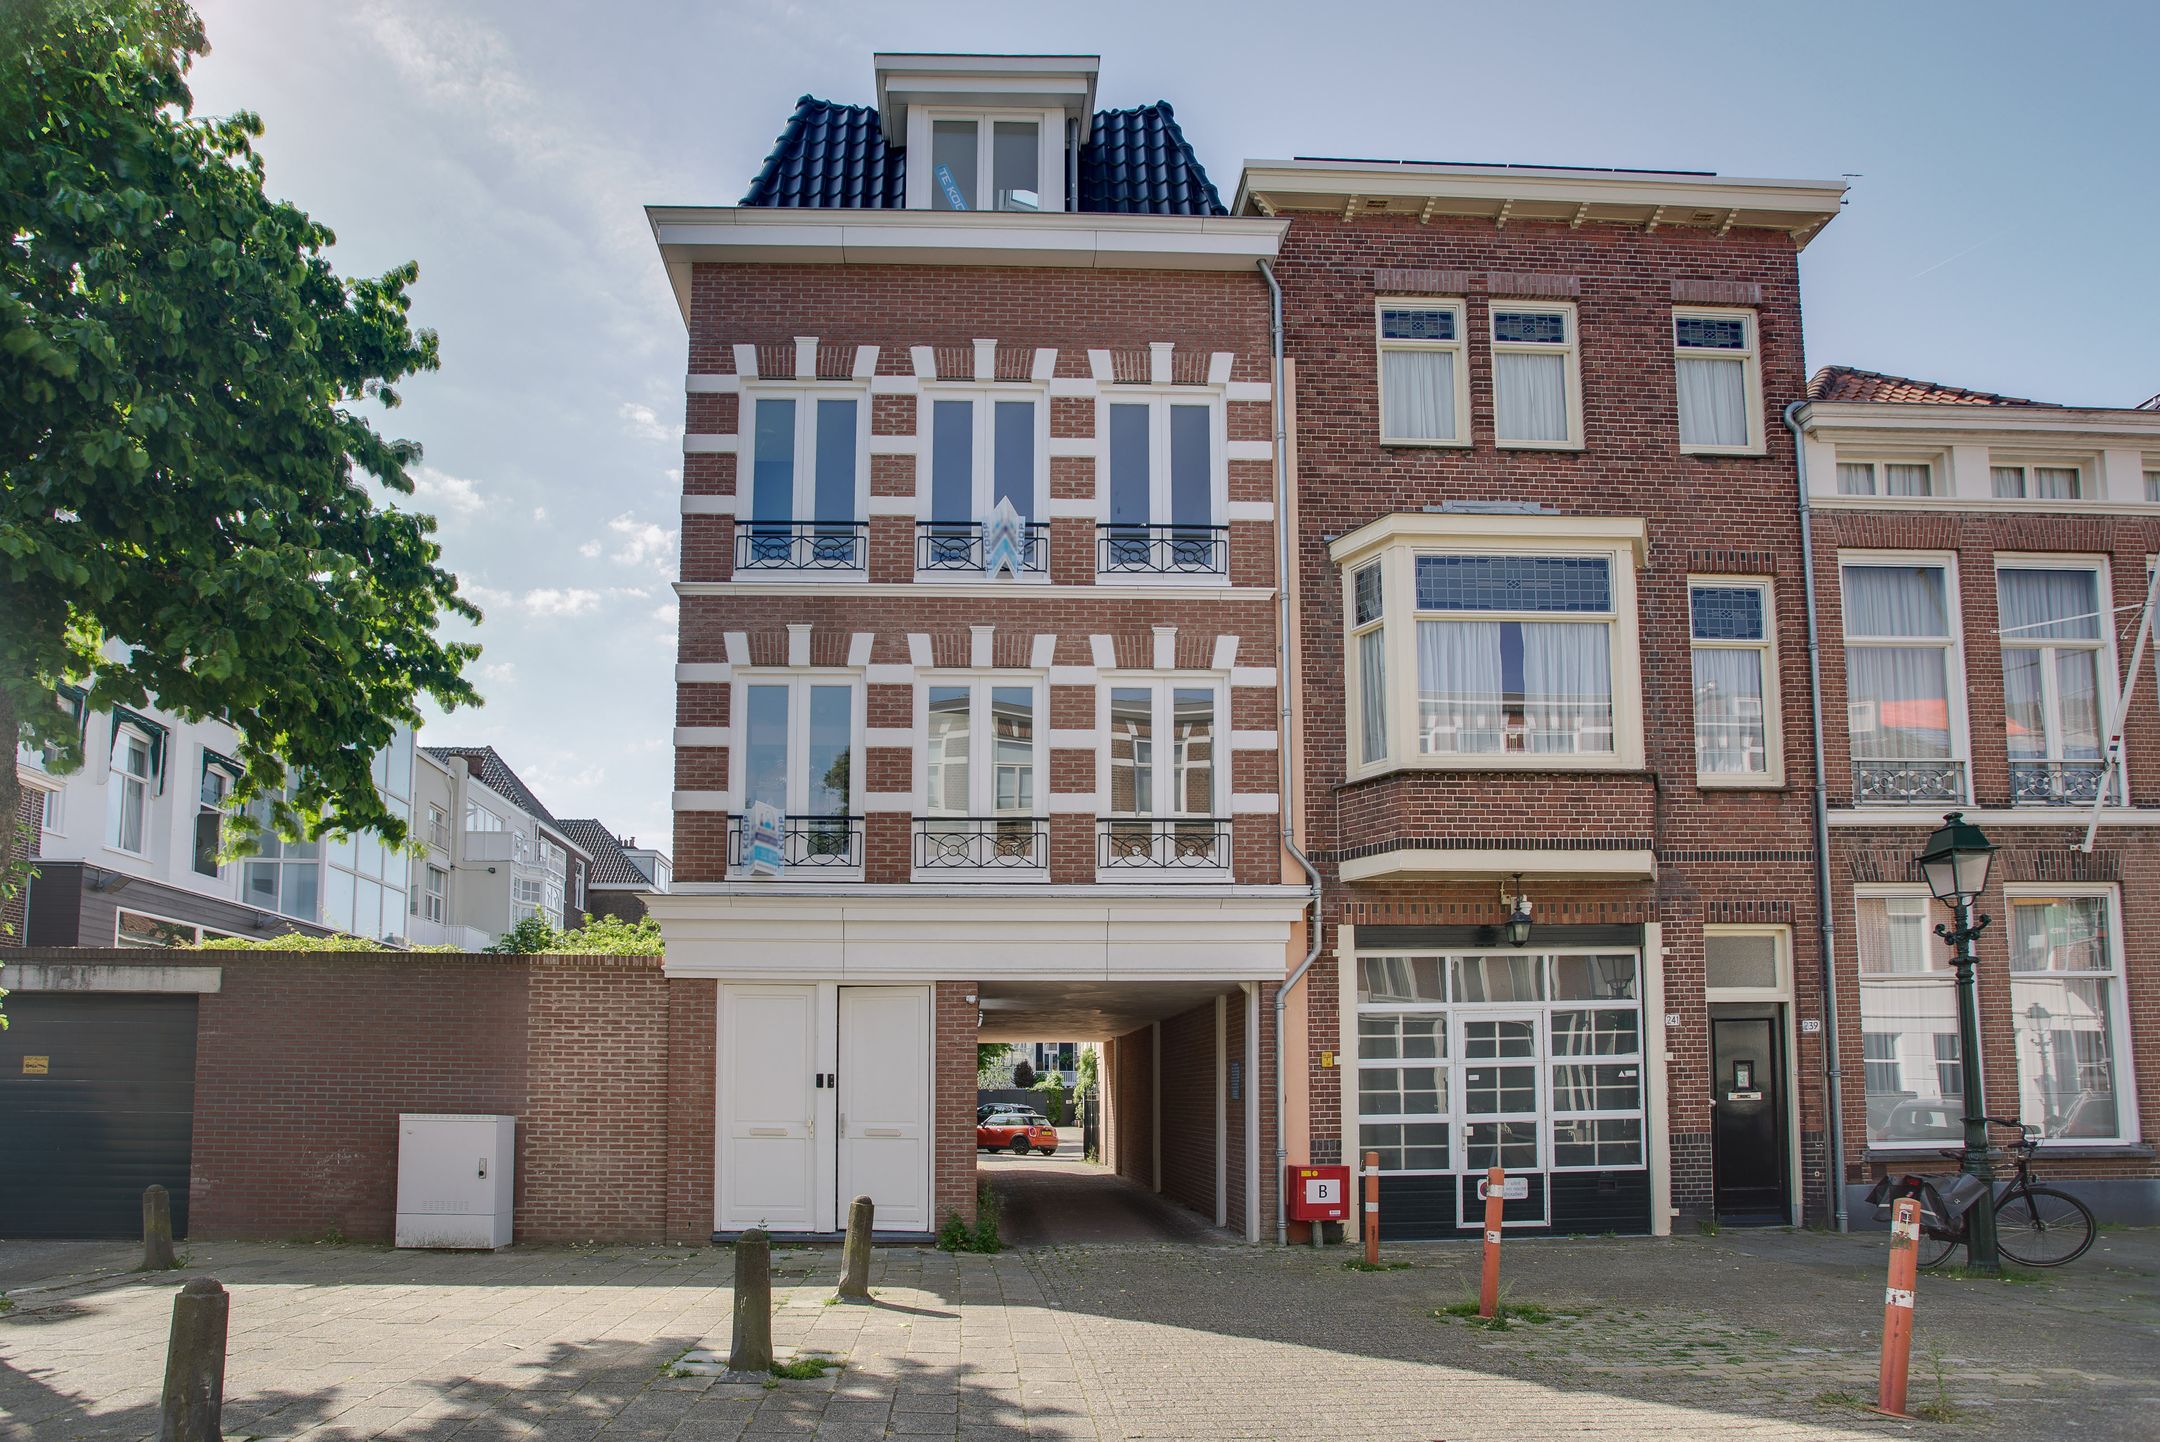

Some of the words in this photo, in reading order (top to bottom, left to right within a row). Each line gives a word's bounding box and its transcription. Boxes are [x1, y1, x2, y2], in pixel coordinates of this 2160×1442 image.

[939, 167, 952, 185] TE
[946, 186, 966, 210] KOO
[982, 523, 991, 554] KOOP
[1017, 523, 1025, 555] KOOP
[985, 559, 993, 573] TE
[1016, 560, 1023, 573] TE
[742, 854, 749, 868] TE
[778, 855, 785, 869] TE
[1666, 1015, 1679, 1025] 241
[1804, 1021, 1818, 1030] 239
[1318, 1185, 1328, 1198] B
